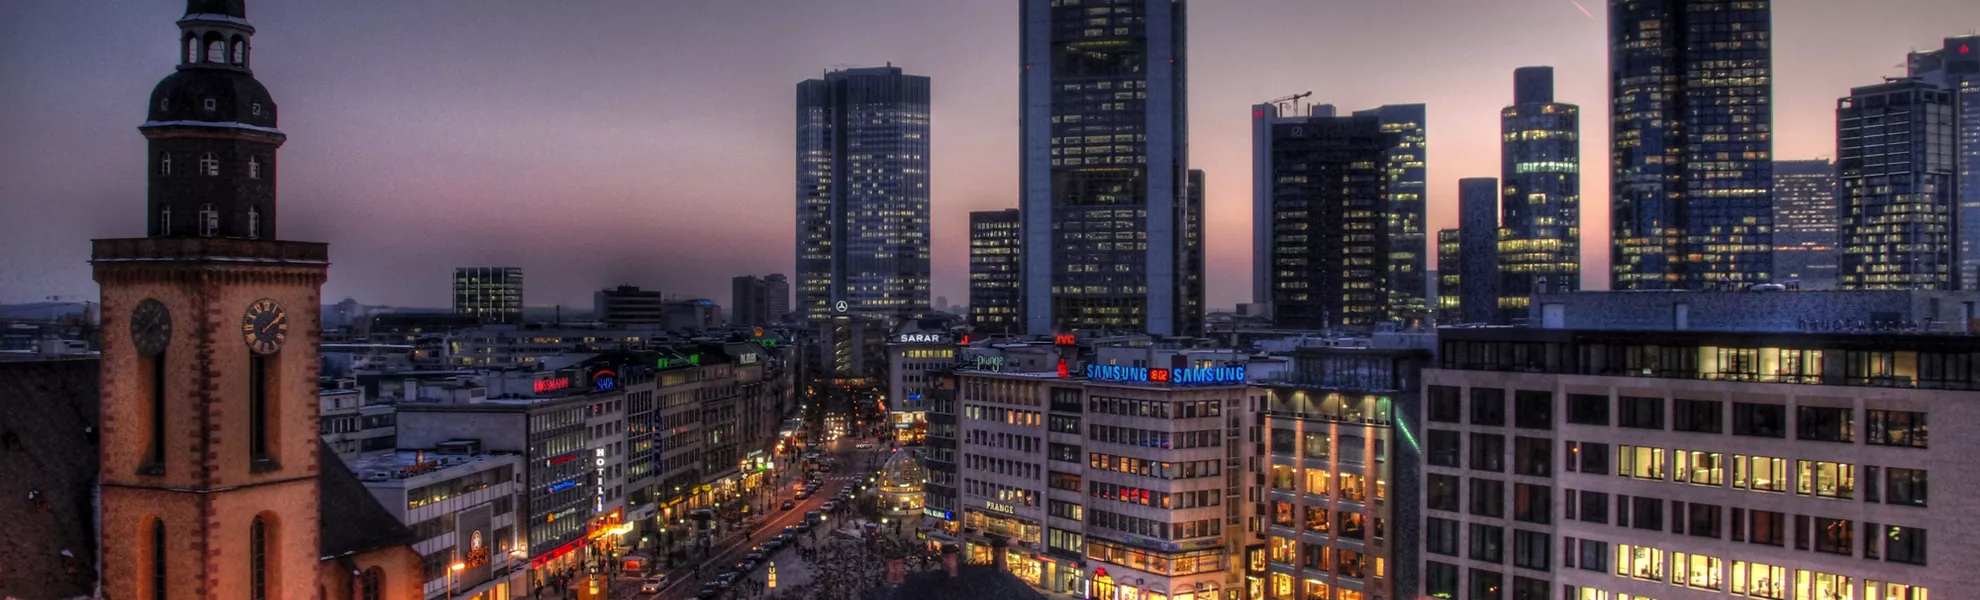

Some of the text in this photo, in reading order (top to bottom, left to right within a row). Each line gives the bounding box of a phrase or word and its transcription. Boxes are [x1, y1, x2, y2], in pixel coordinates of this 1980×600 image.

[901, 334, 939, 342] SARAR
[1055, 335, 1075, 344] JVC
[977, 356, 1004, 372] Prange
[1087, 364, 1147, 381] SAMSUNG
[1173, 367, 1244, 383] SAMSUNG
[596, 448, 605, 495] HOTEL
[986, 501, 1014, 514] PRANGE
[467, 545, 489, 561] SPORT
